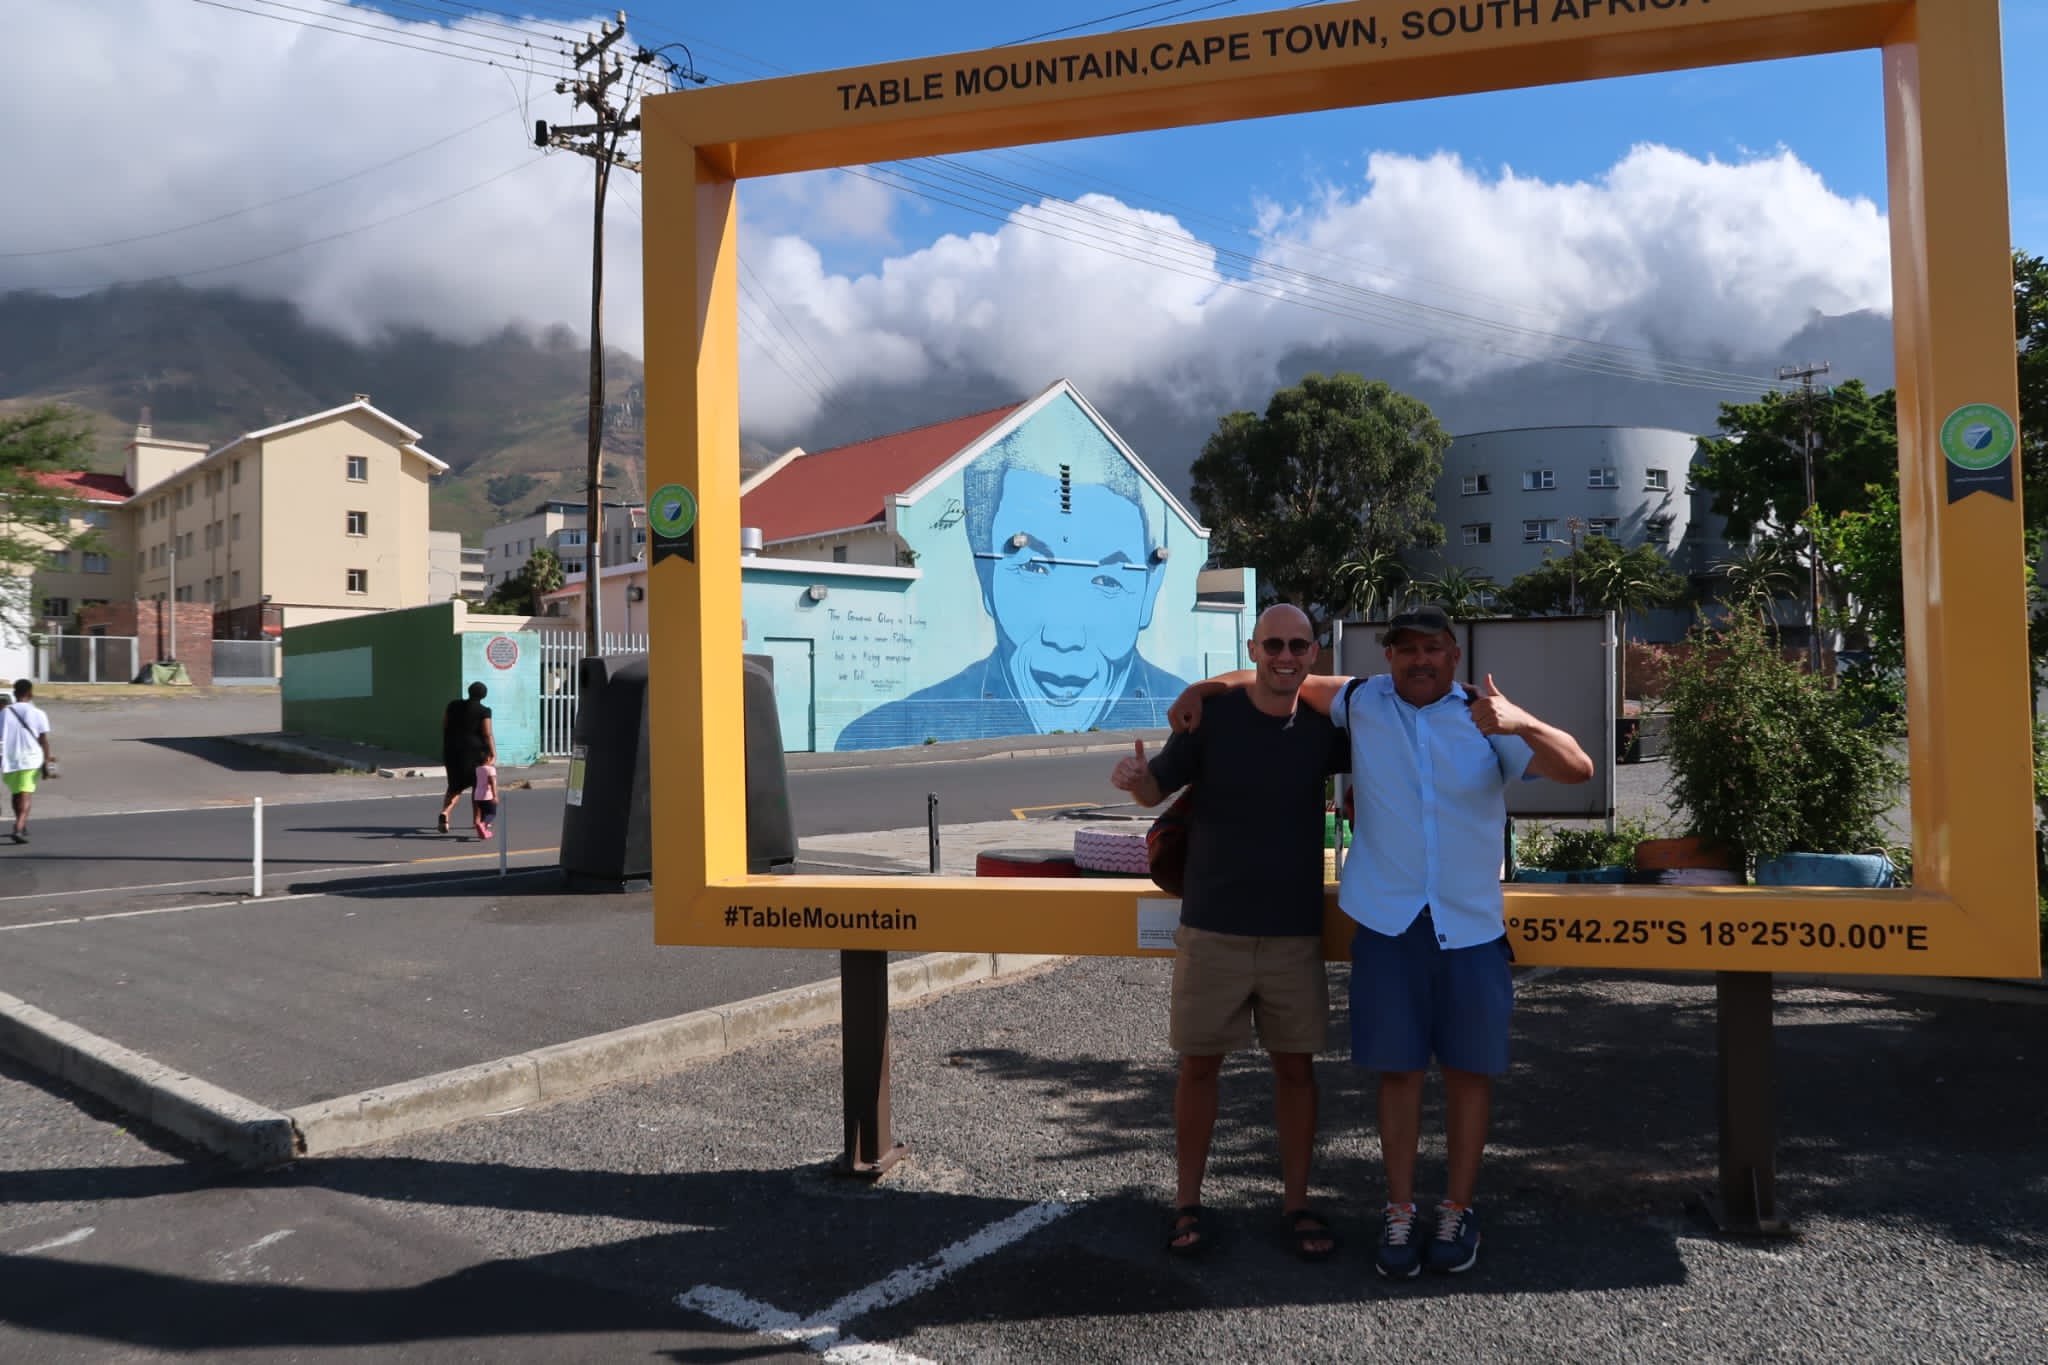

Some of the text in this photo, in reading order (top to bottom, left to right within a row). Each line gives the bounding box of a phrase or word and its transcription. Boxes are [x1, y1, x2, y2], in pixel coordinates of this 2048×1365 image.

[836, 72, 944, 111] TABLE
[1262, 16, 1388, 57] TOWN,
[1401, 0, 1539, 41] SOUTH
[1551, 0, 1713, 22] AFR
[724, 905, 917, 931] #TableMountain
[1503, 917, 1929, 951] °55'42.25"S 18°25'30.00"E
